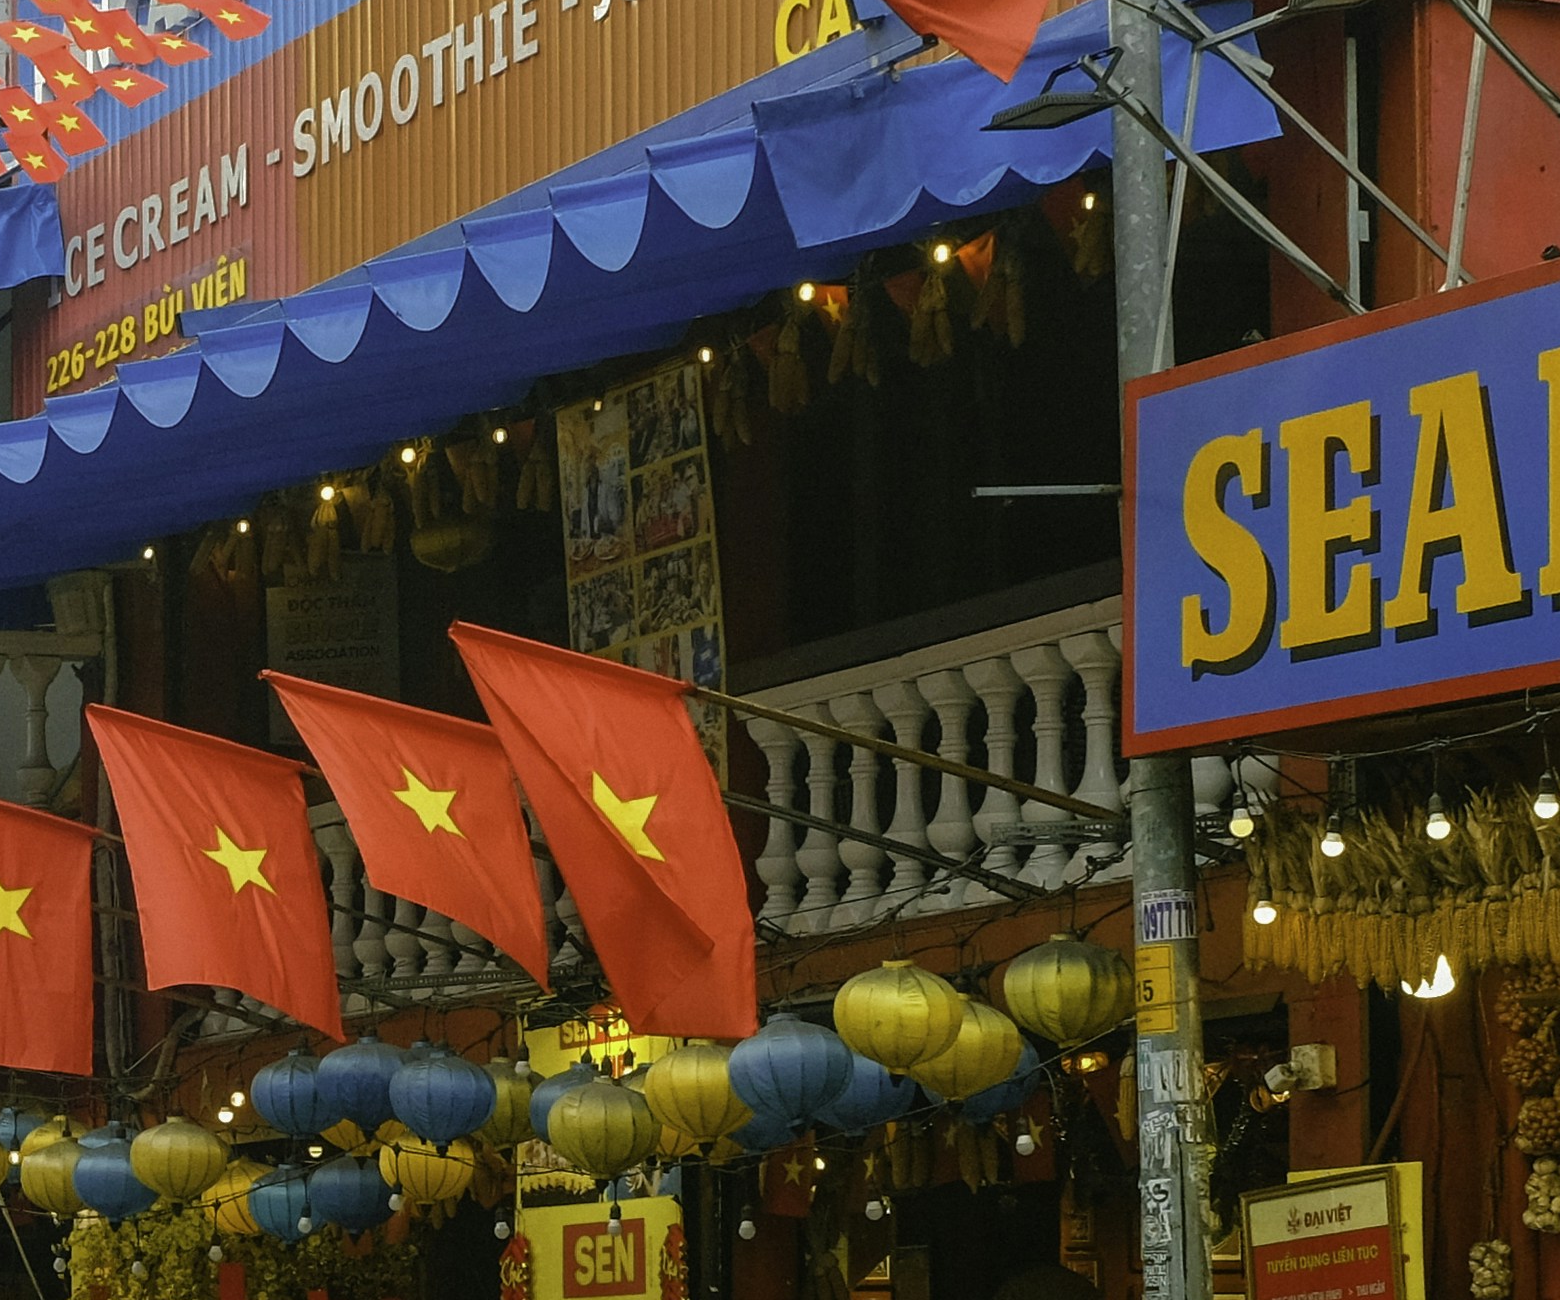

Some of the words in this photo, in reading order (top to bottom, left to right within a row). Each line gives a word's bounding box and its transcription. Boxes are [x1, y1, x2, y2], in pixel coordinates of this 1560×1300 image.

[112, 143, 247, 270] CREAM
[46, 315, 137, 394] 226-228
[574, 1234, 636, 1286] SEN
